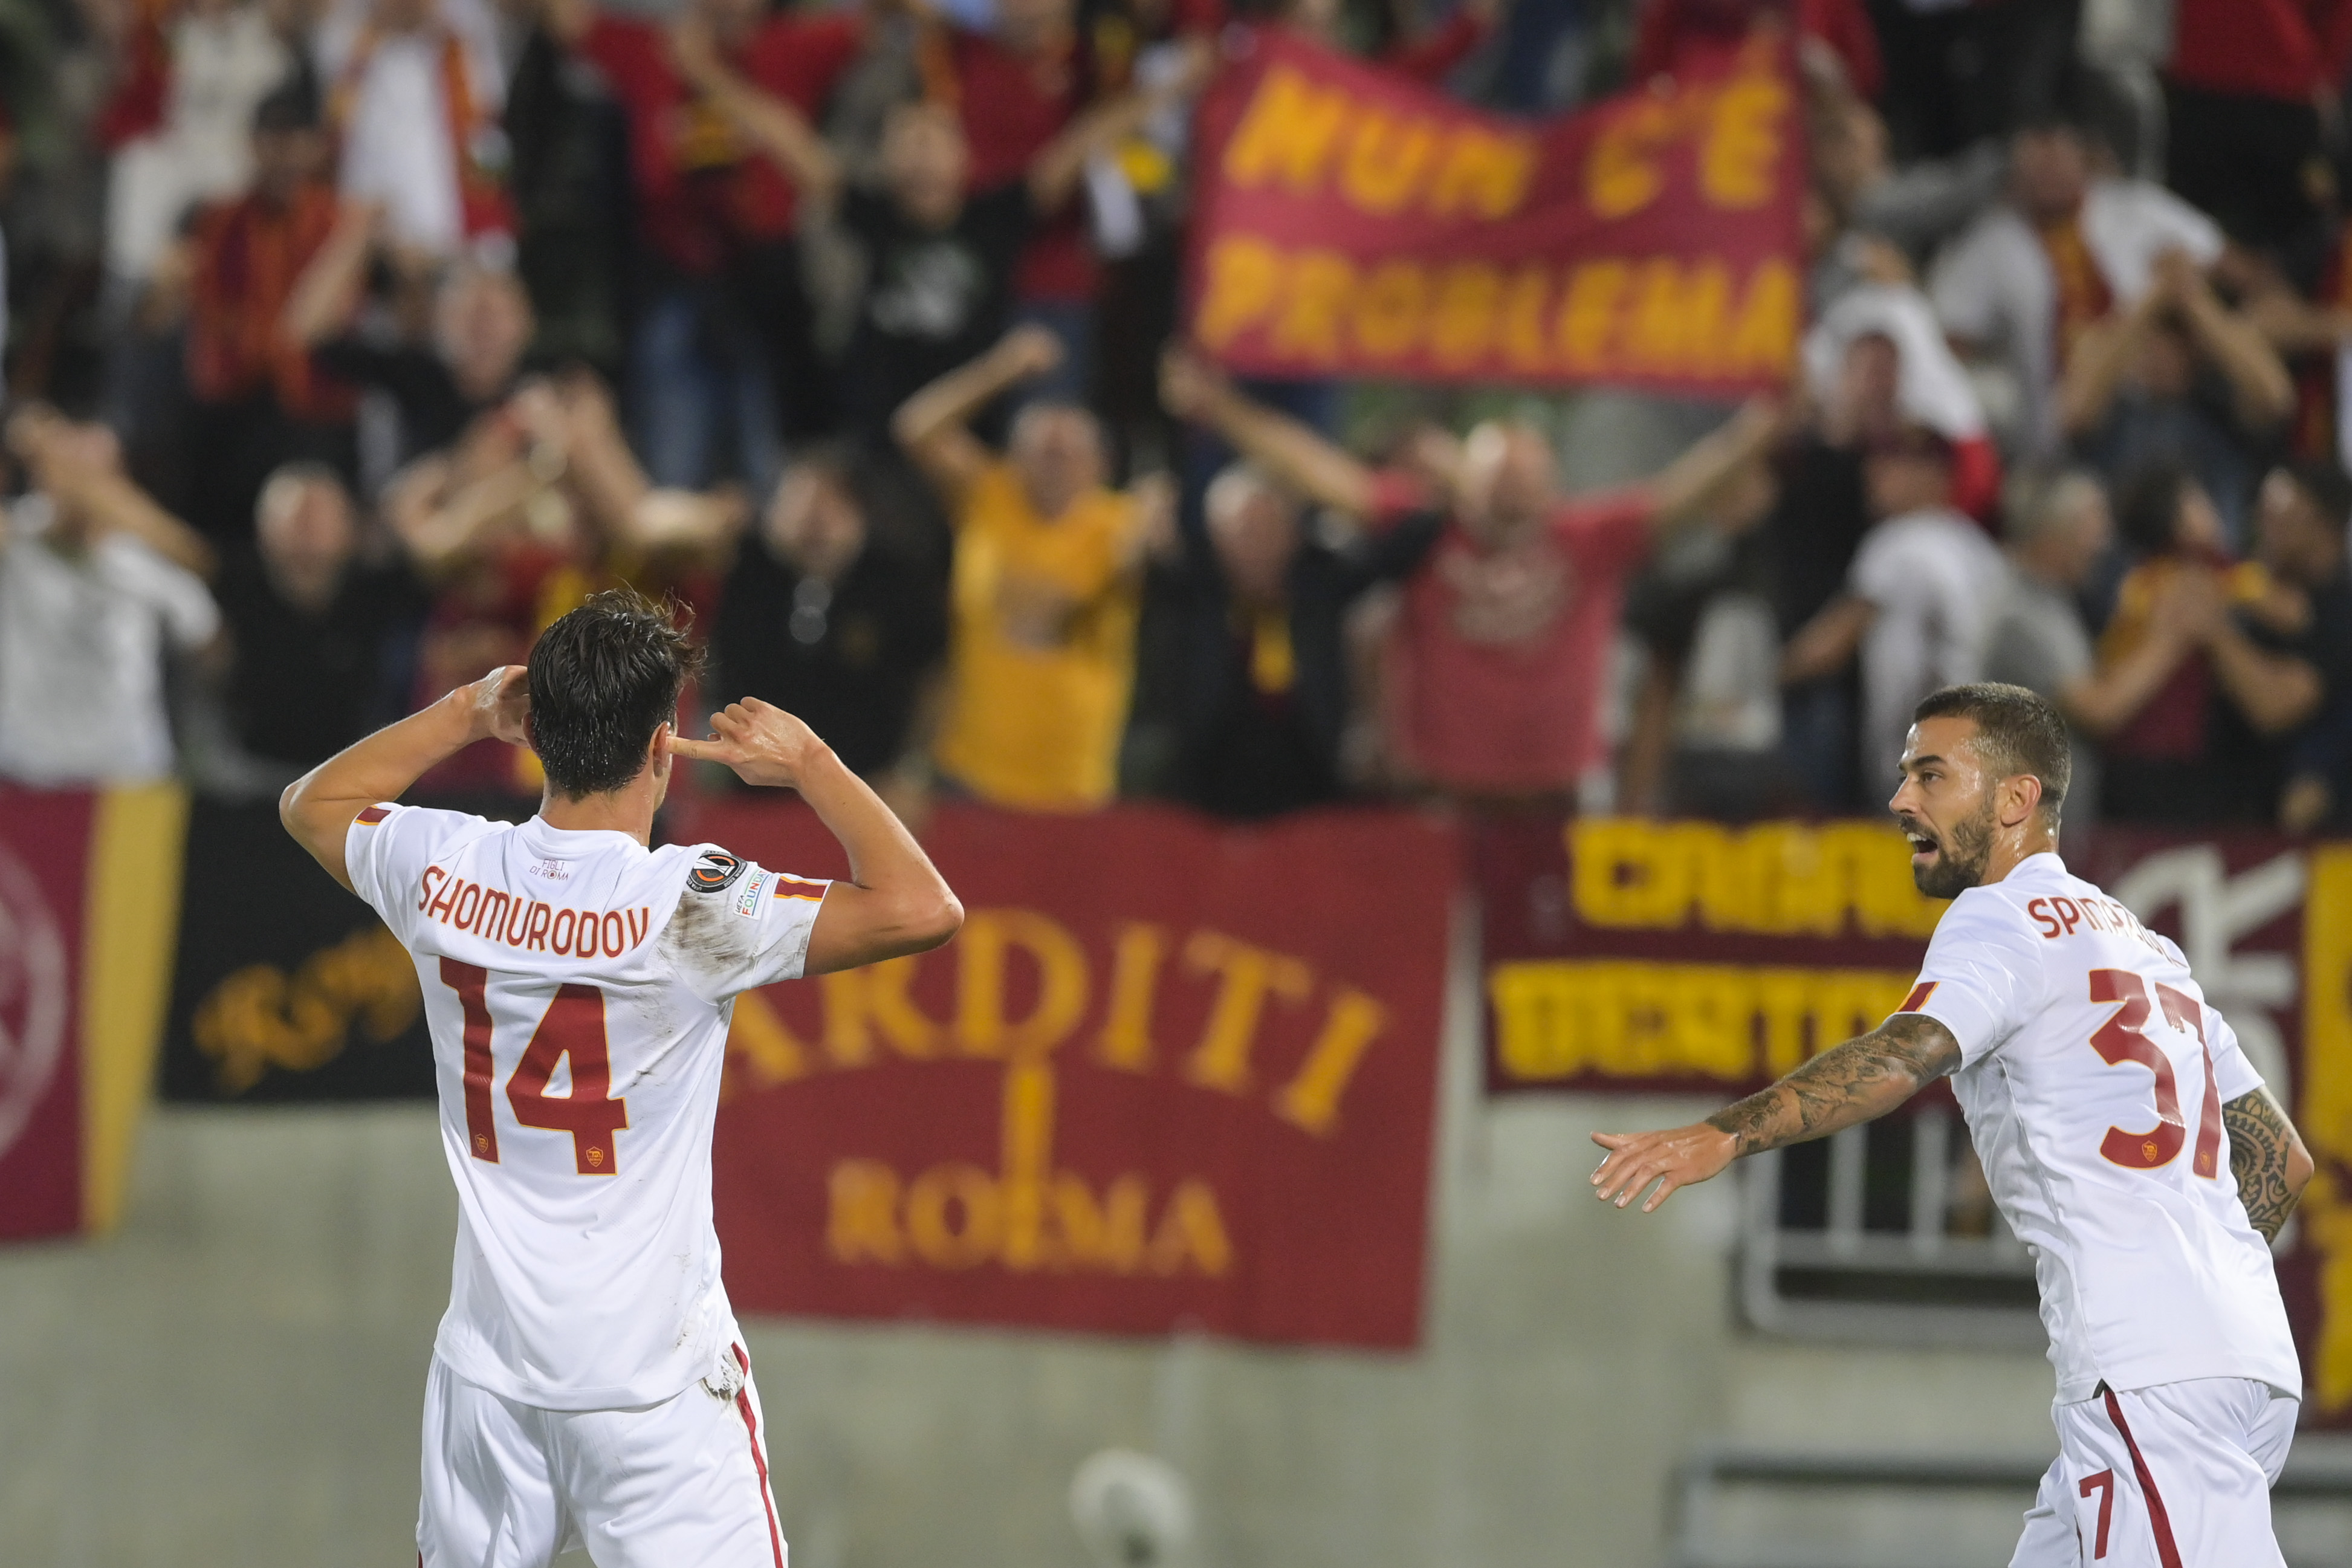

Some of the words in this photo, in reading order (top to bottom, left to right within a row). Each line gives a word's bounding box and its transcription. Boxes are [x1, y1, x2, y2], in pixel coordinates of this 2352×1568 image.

[530, 866, 541, 875] DI
[541, 869, 569, 881] ROMA
[542, 858, 565, 871] FIGLI
[741, 869, 769, 916] FOUNDAT
[418, 865, 650, 959] SHOMURODOV
[734, 895, 745, 913] UEFA
[439, 955, 629, 1176] 14
[2088, 968, 2223, 1181] 37
[827, 1156, 1237, 1277] ROMA
